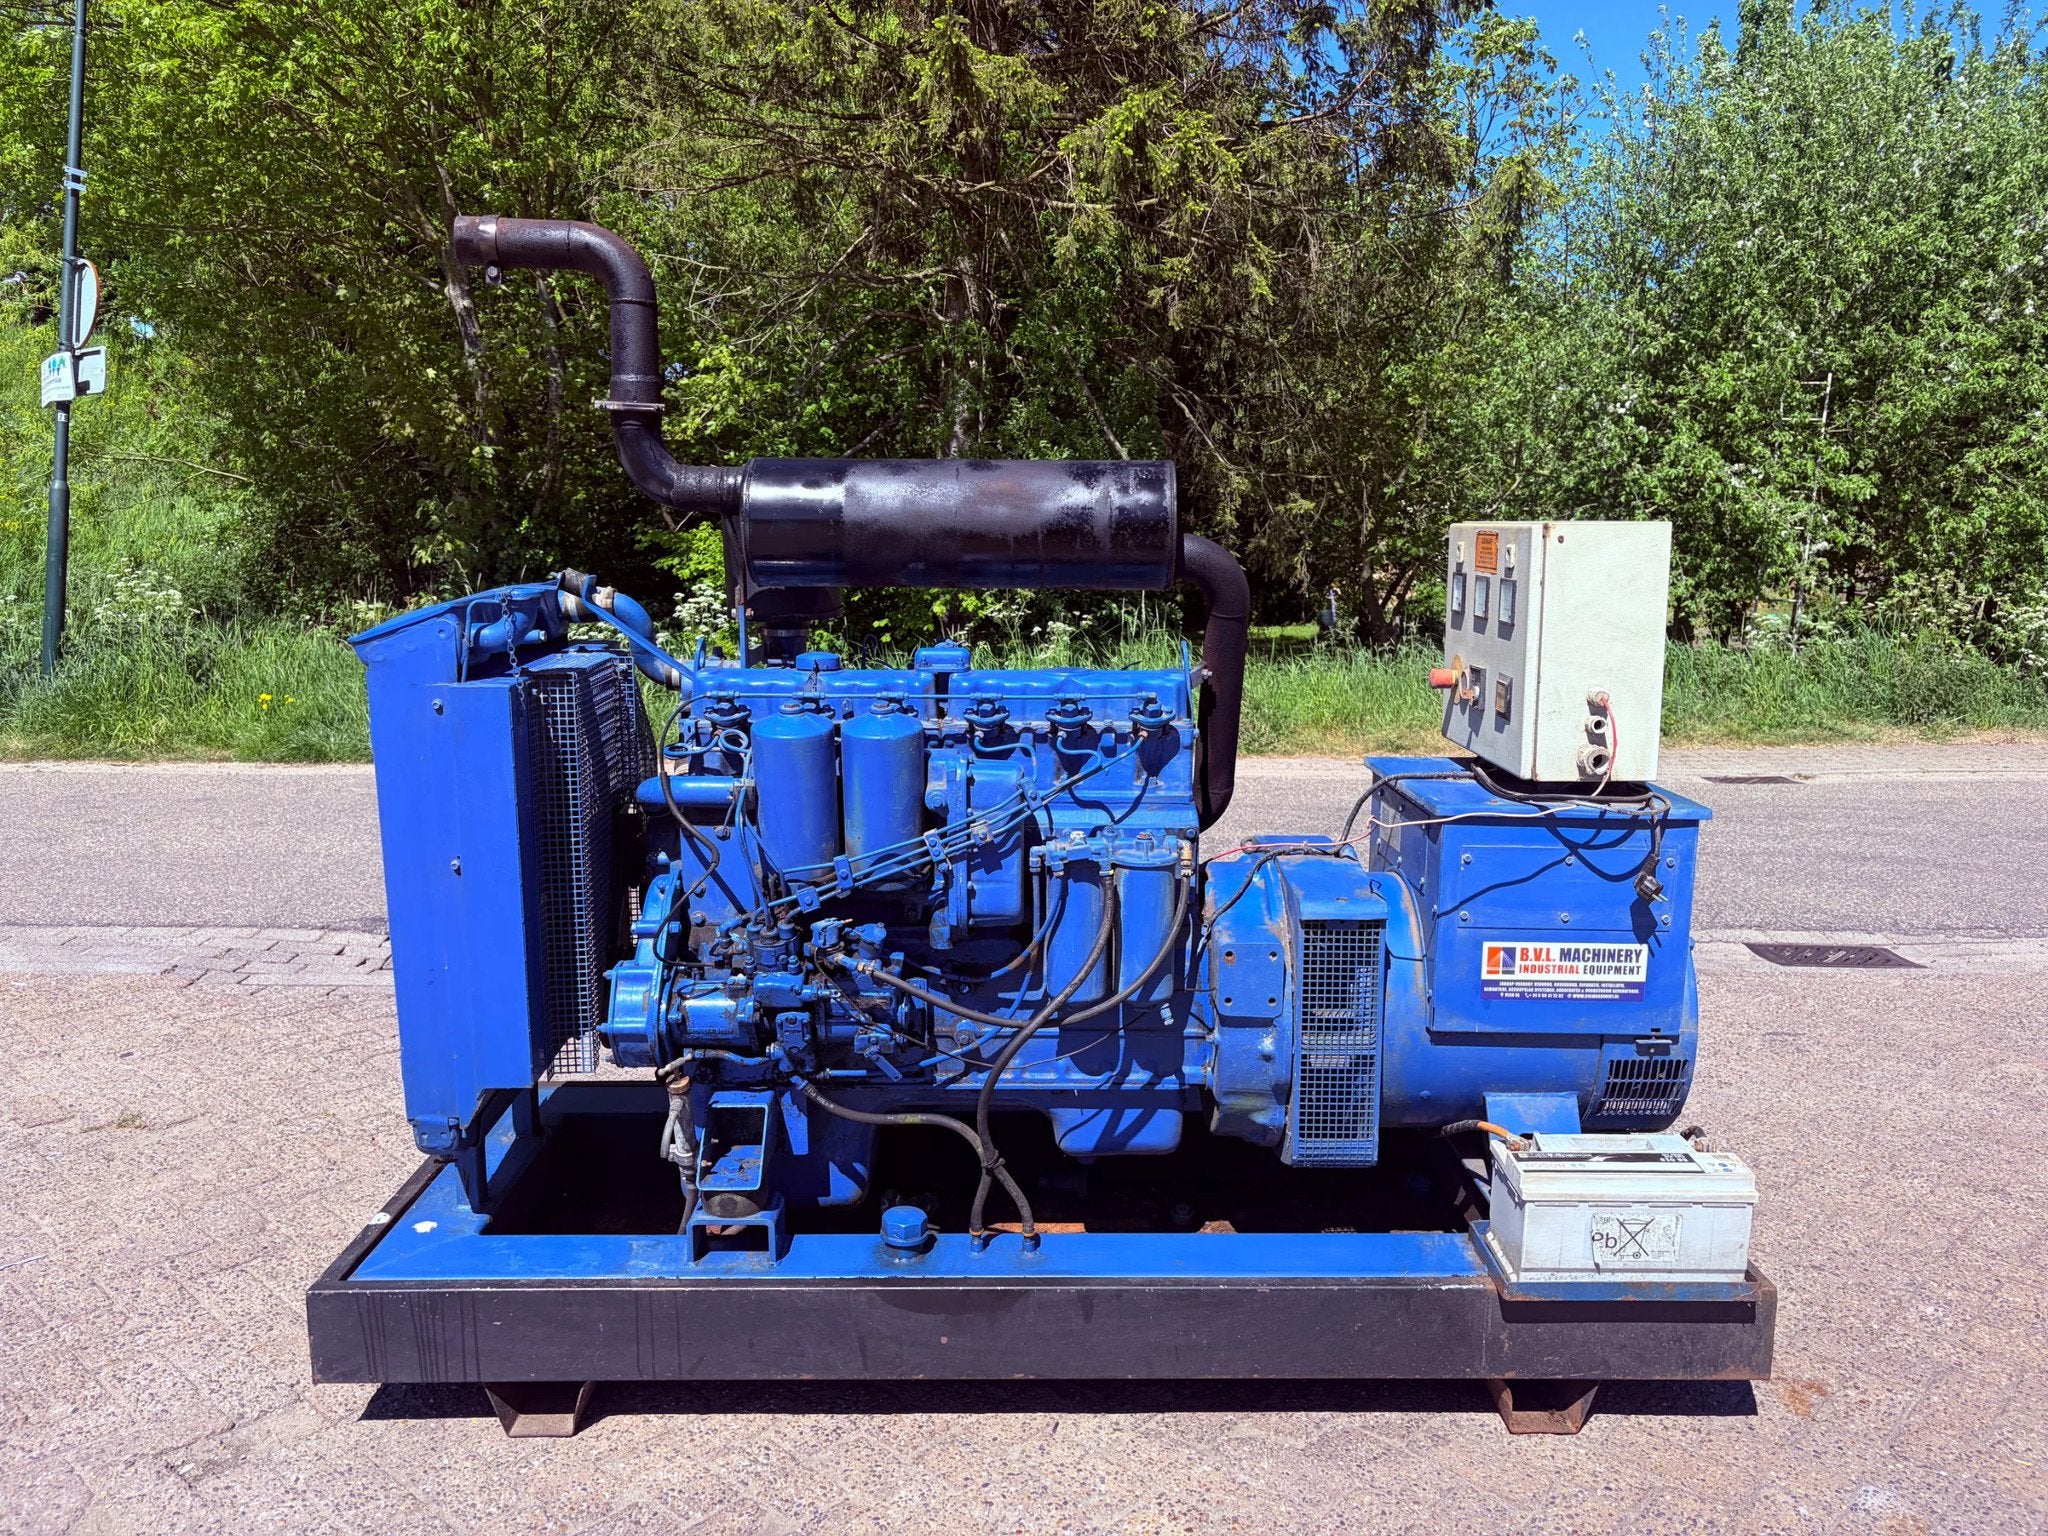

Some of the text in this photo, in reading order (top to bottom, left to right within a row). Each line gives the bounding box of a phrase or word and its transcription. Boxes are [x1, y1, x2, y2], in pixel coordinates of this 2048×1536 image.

[1520, 947, 1642, 963] B.V.L. MACHINERY
[1519, 964, 1642, 976] INDUSTRIAL EQUIPMENT
